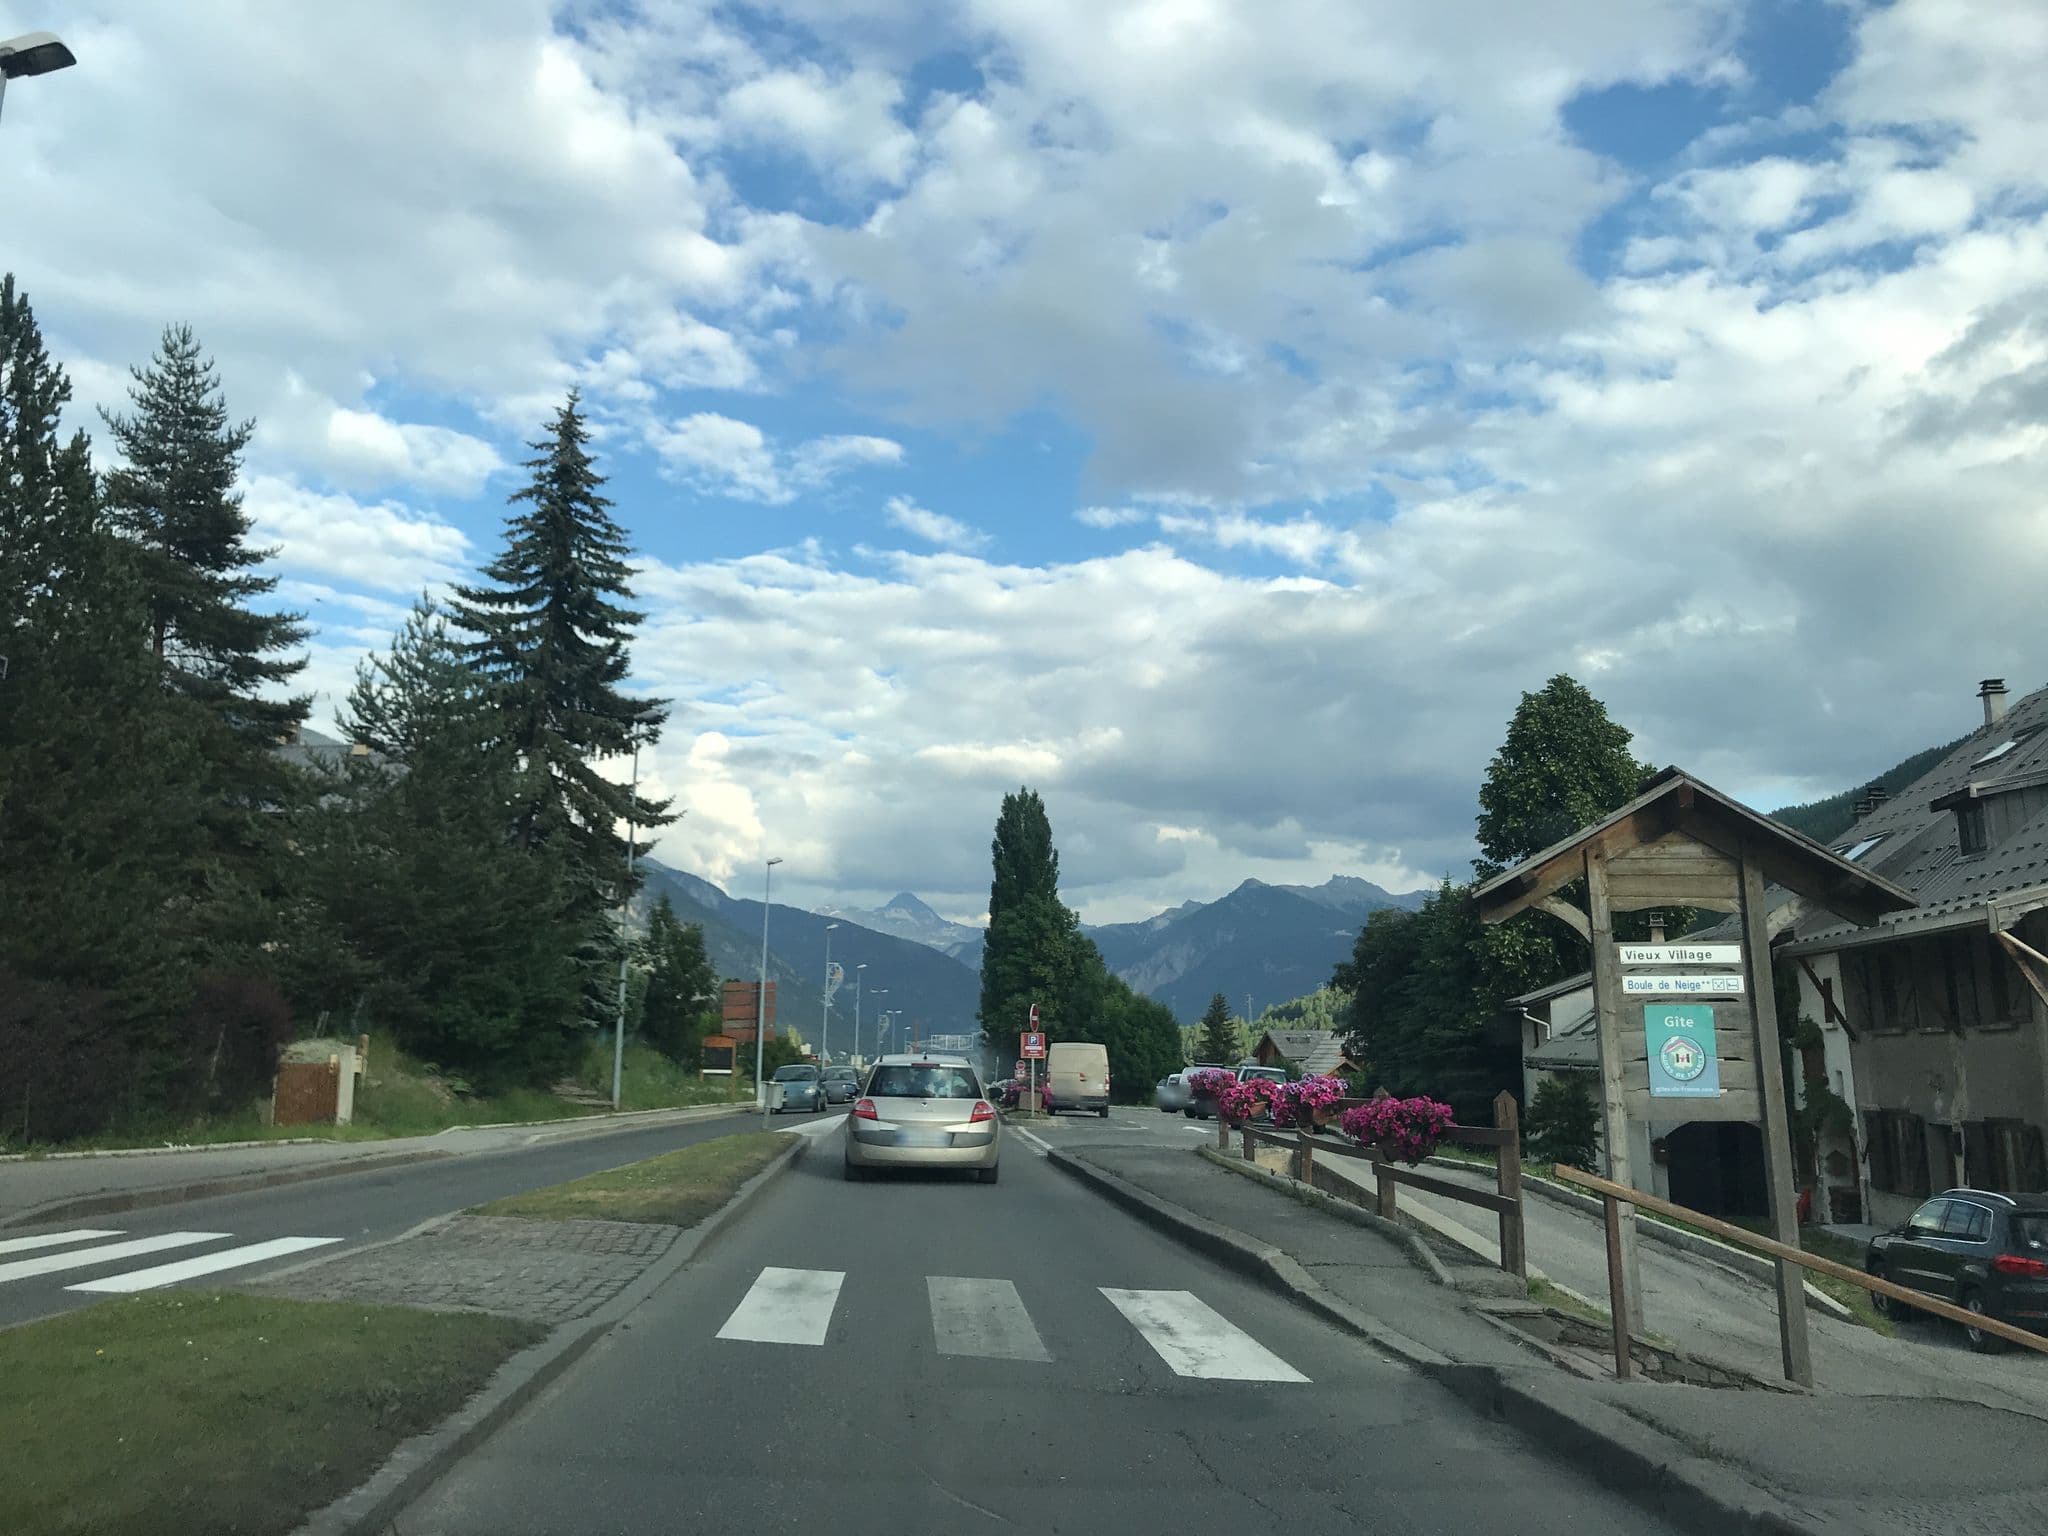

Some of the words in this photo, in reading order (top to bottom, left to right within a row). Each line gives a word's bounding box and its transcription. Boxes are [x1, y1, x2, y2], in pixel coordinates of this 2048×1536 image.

[1625, 950, 1661, 960] Vieux
[1668, 950, 1712, 961] Village
[1627, 980, 1653, 990] Boule
[1658, 980, 1670, 990] de
[1664, 1016, 1694, 1028] Gîte
